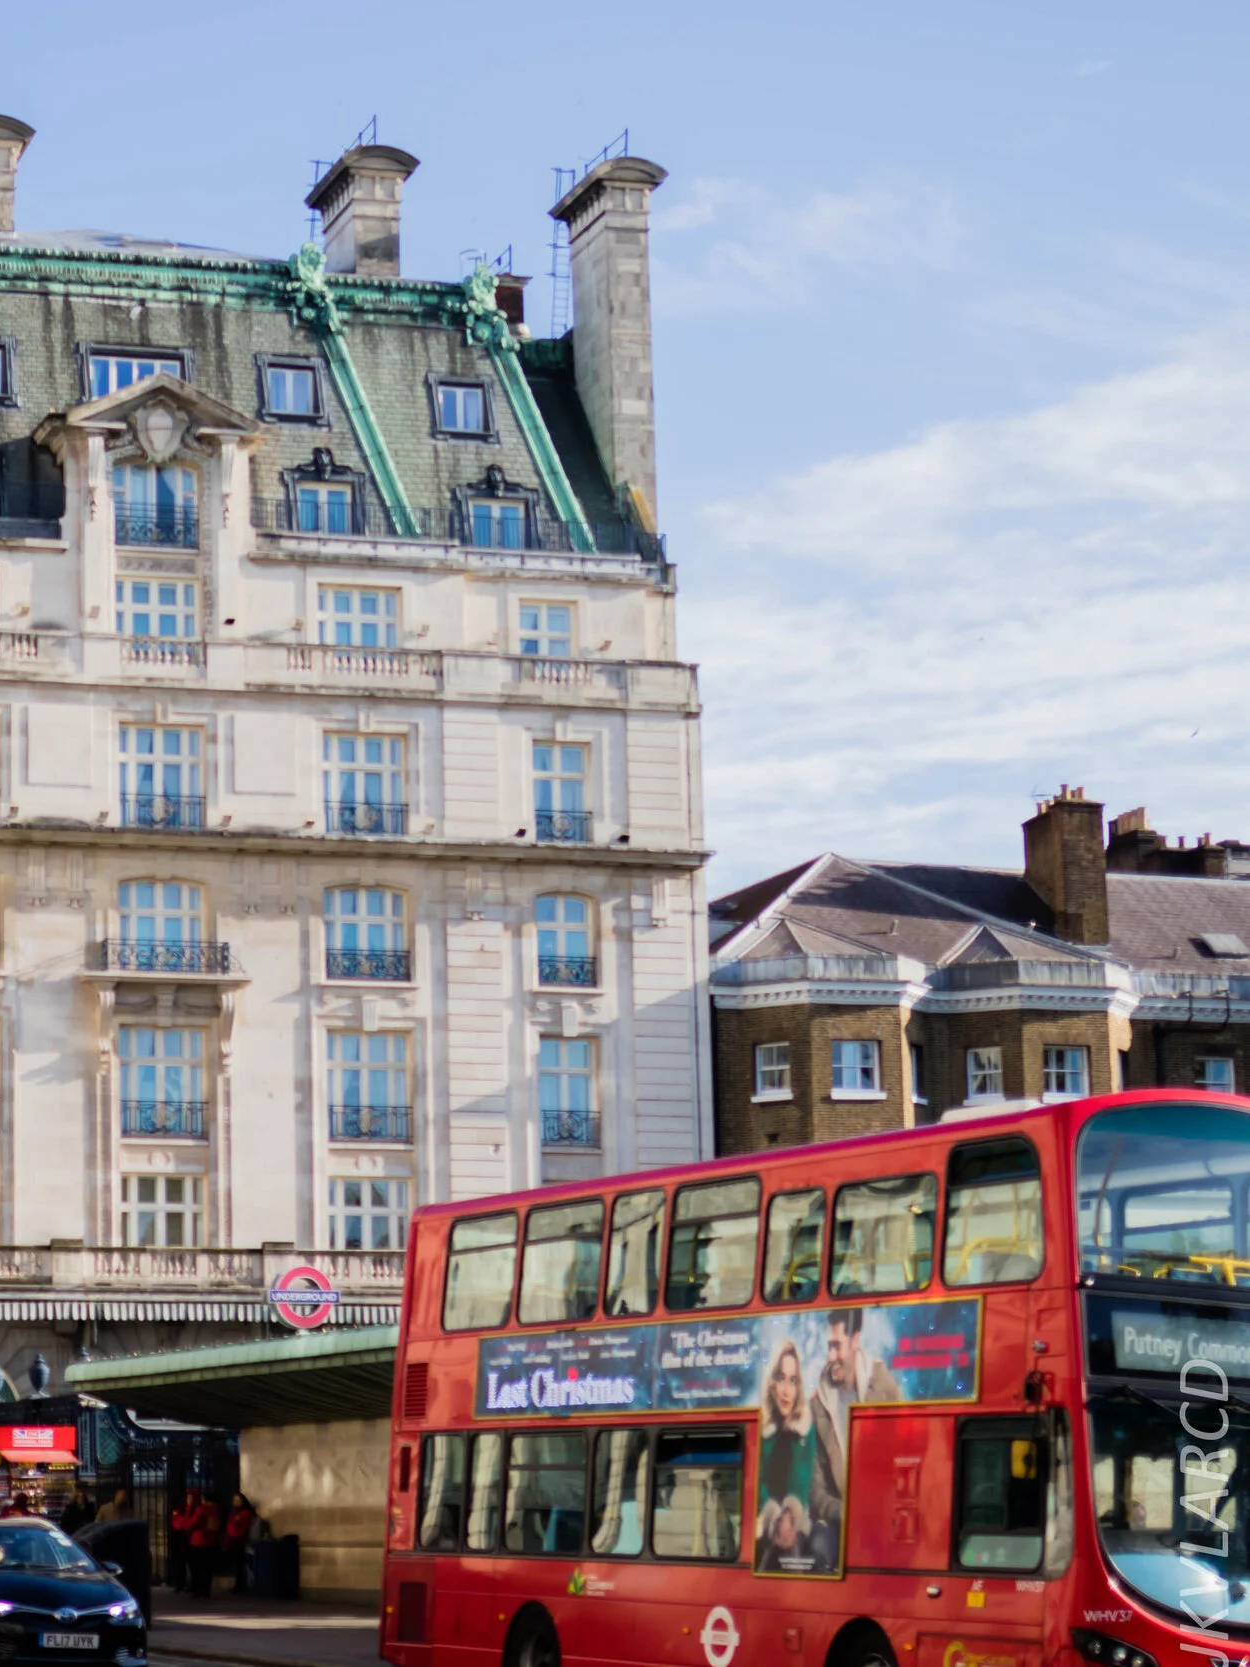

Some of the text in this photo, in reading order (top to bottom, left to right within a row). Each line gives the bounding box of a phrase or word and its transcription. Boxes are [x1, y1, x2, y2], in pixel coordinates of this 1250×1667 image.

[271, 1292, 338, 1302] UNDERGROUND
[1124, 1326, 1183, 1365] Putney
[486, 1366, 636, 1409] Last Christmas
[1083, 1609, 1134, 1623] WHV37
[46, 1635, 70, 1647] FL17
